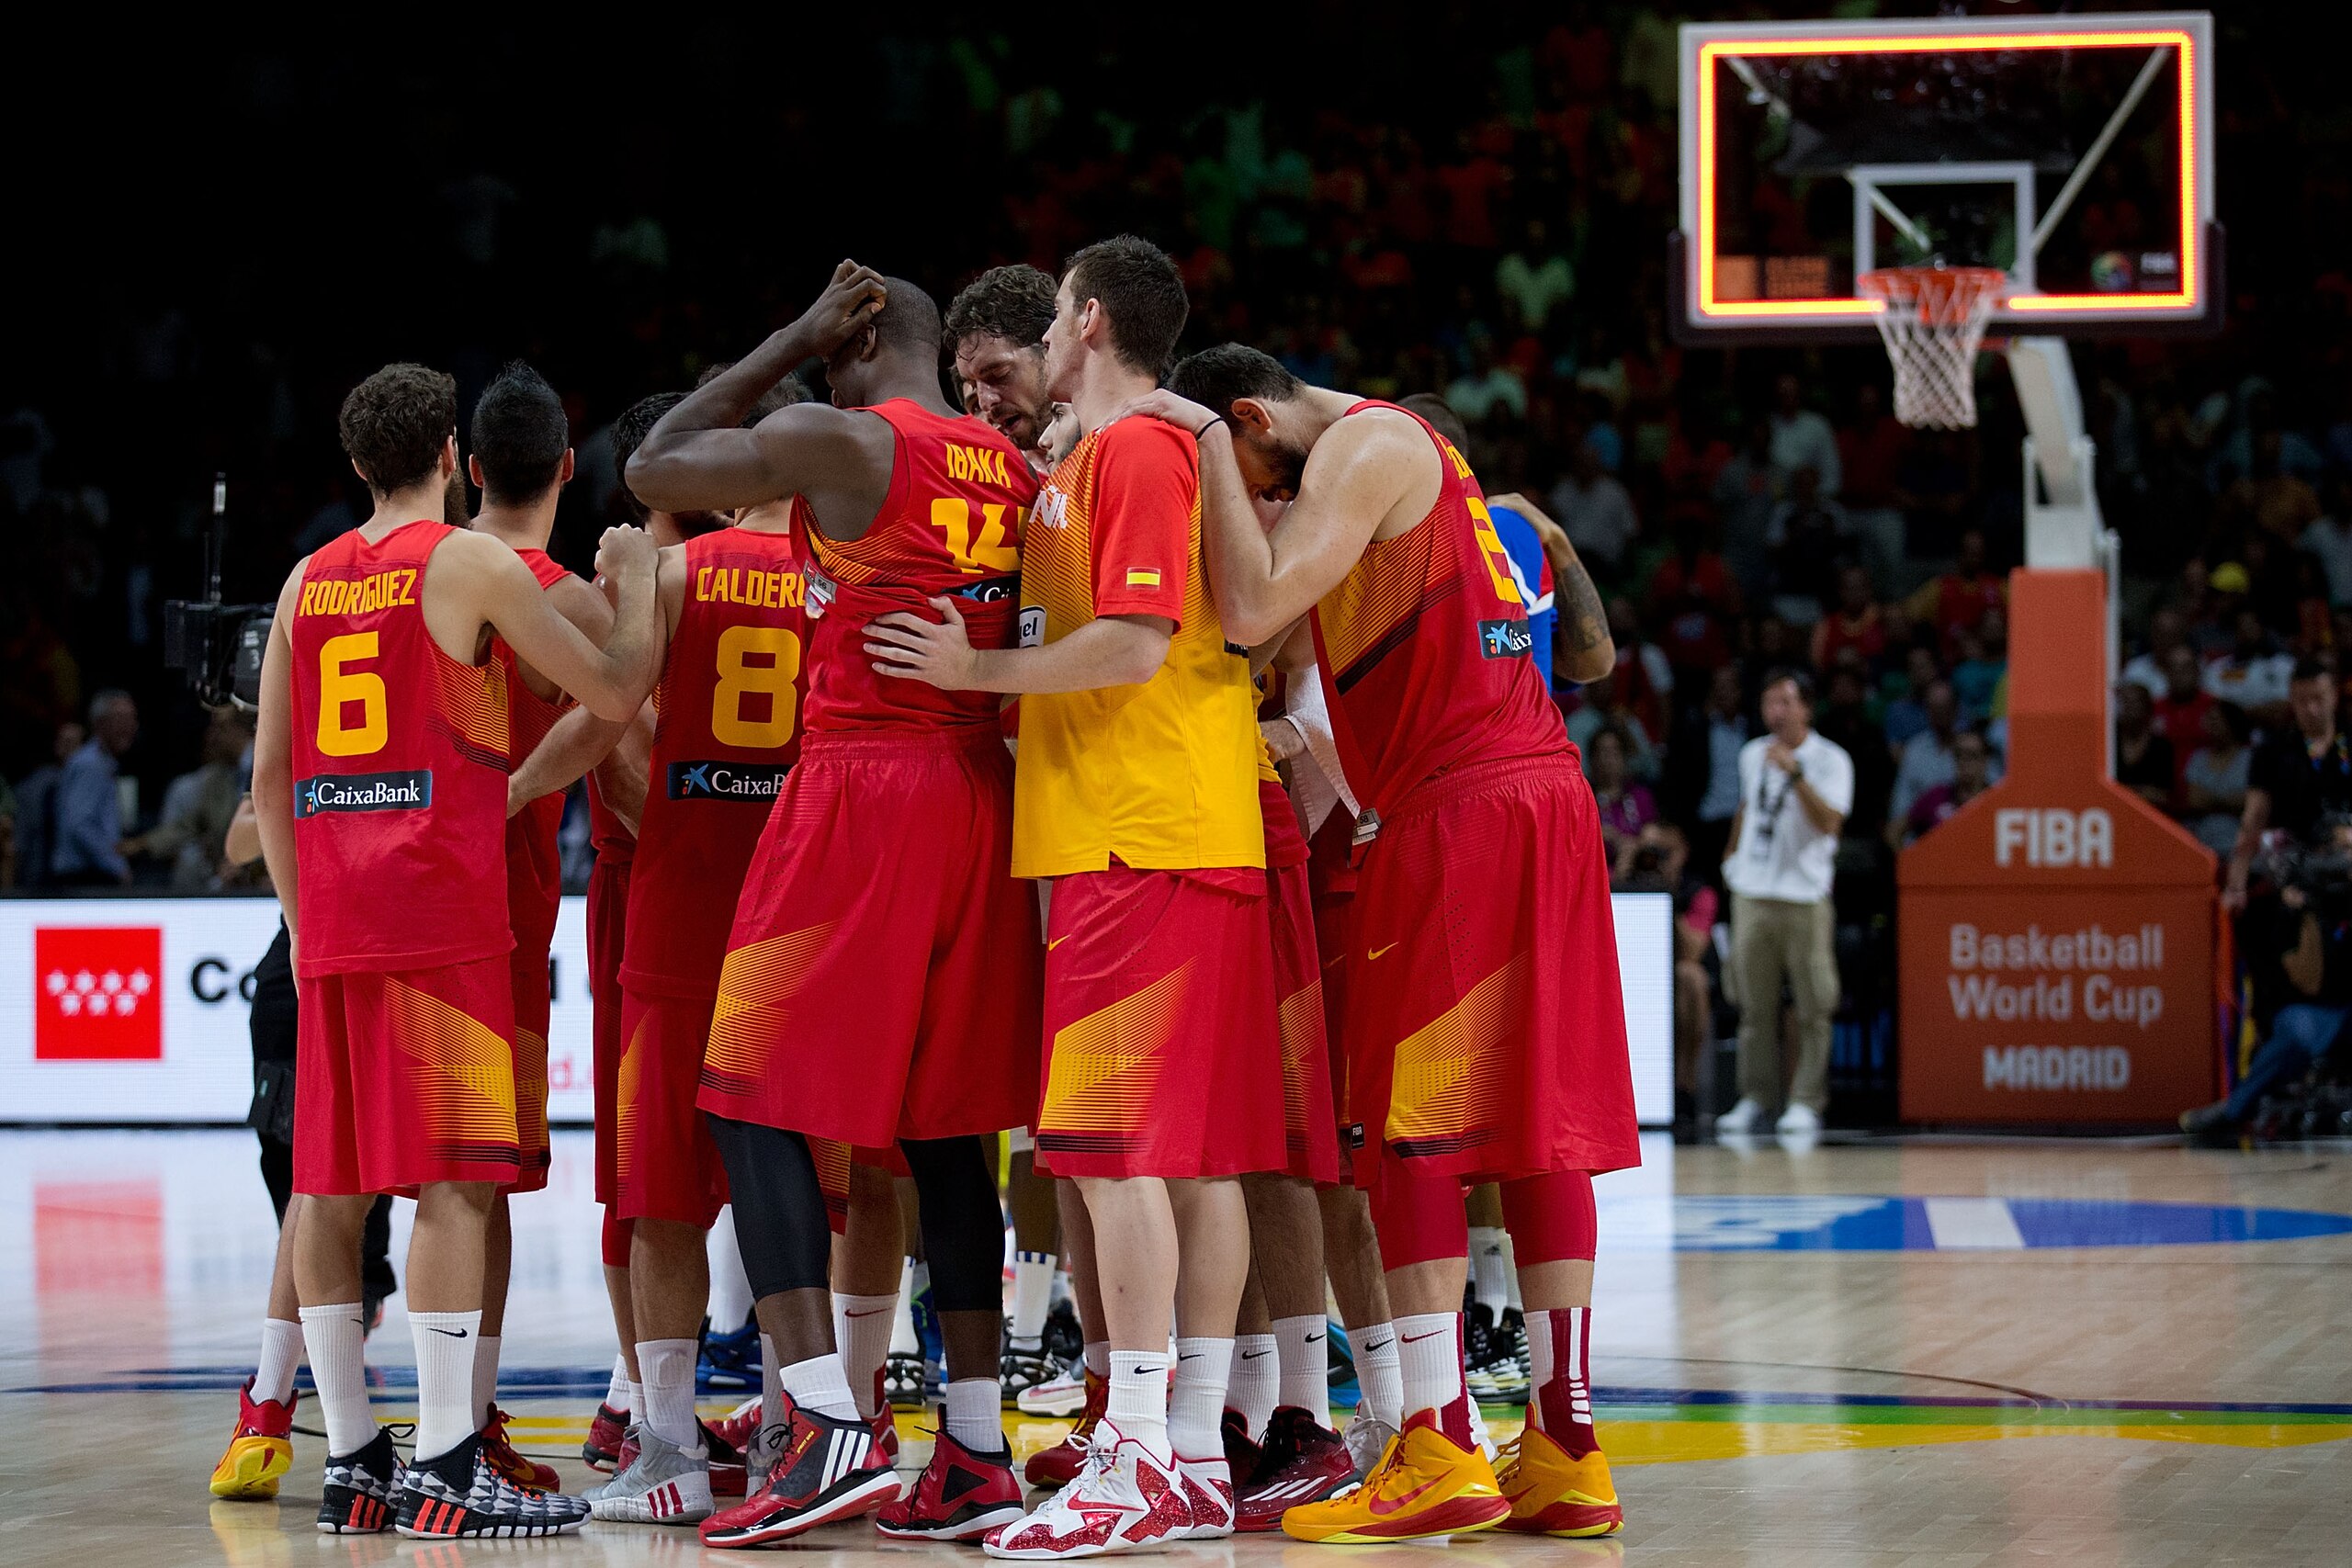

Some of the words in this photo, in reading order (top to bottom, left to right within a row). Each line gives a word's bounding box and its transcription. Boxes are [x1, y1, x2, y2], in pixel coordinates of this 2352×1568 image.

[946, 443, 1012, 489] IBAKA
[299, 569, 417, 617] RODRIGUEZ
[316, 631, 388, 757] 6
[712, 626, 800, 749] 8
[318, 780, 420, 806] CaixaBank
[1994, 807, 2114, 868] FIBA
[1949, 922, 2164, 971] Basketball
[1947, 974, 2074, 1021] World
[2083, 974, 2164, 1031] Cup
[1983, 1044, 2132, 1091] MADRID
